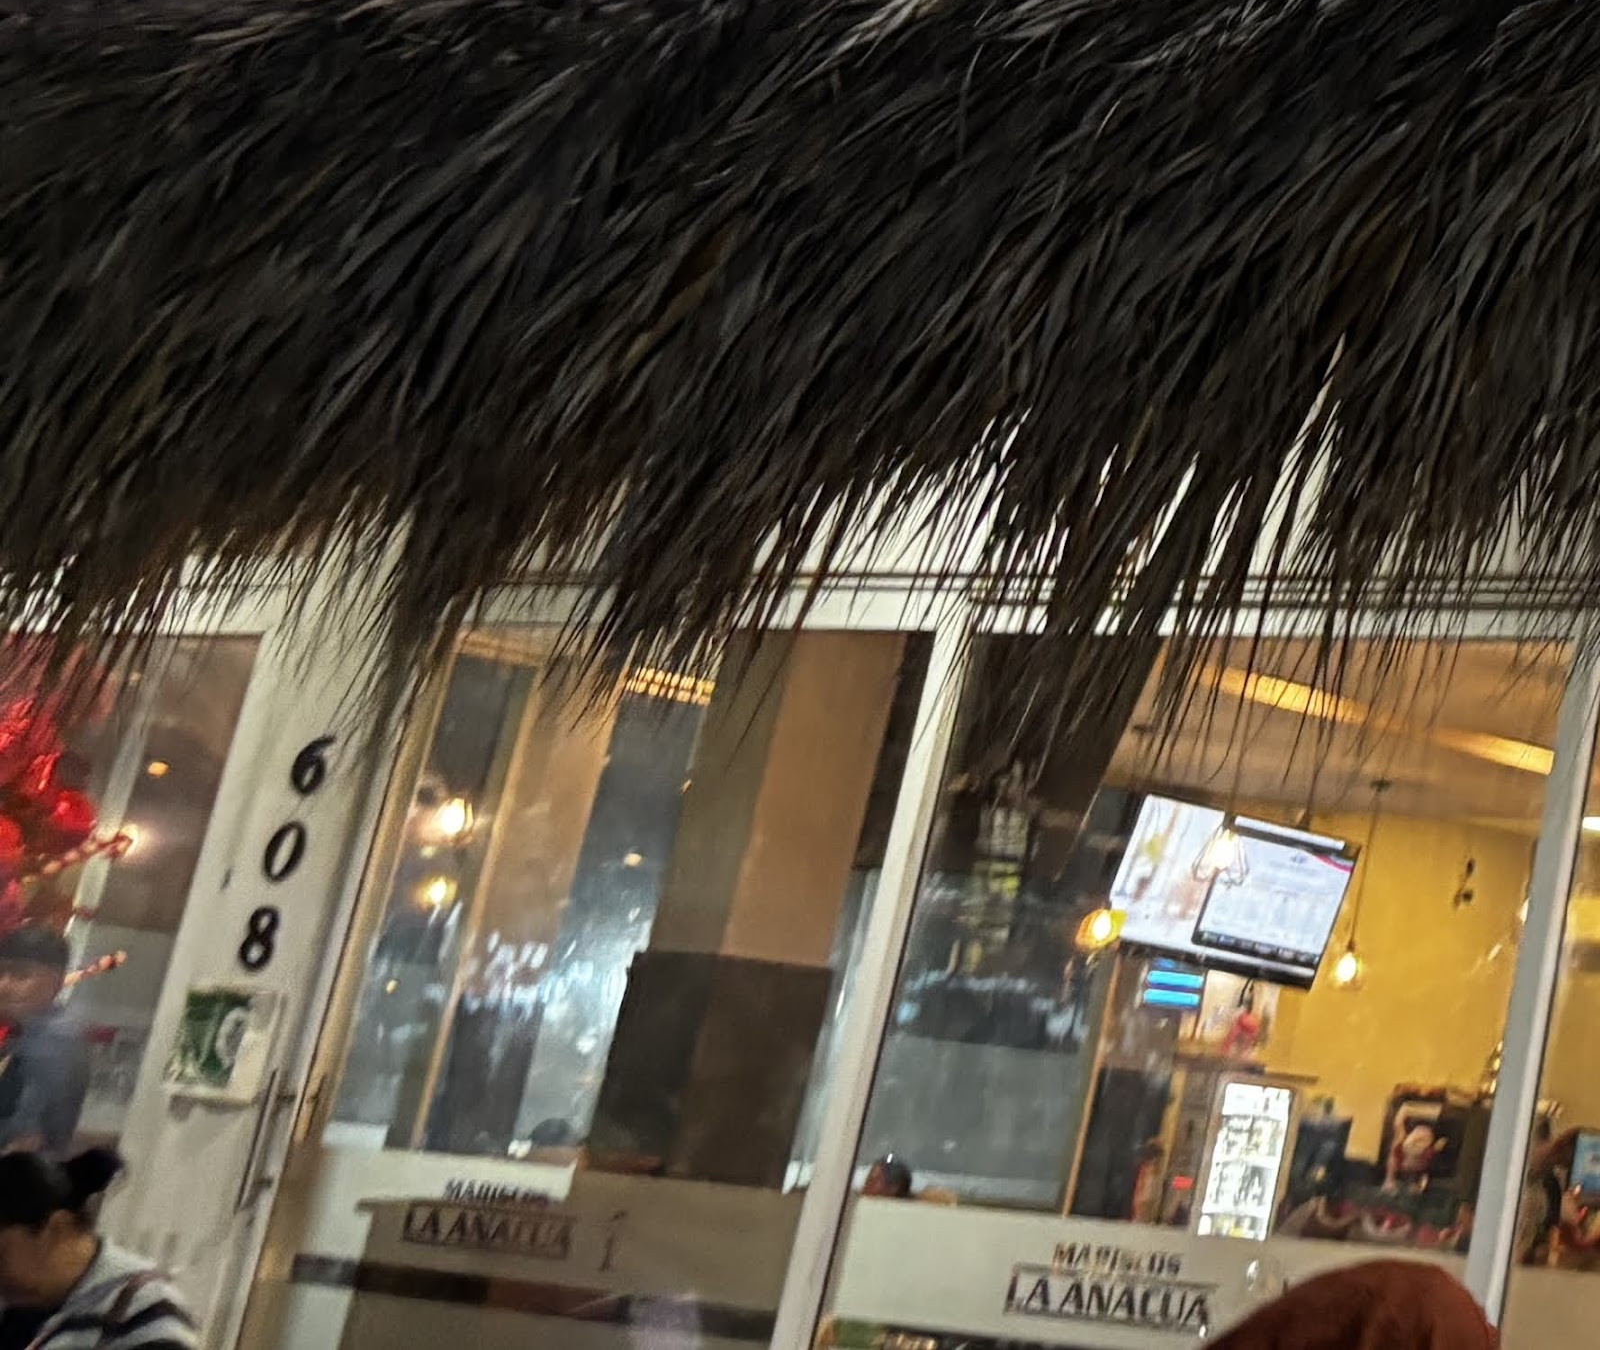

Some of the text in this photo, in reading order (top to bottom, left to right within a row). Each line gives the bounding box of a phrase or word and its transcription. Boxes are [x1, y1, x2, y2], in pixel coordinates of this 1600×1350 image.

[239, 733, 337, 973] 608
[443, 1176, 552, 1204] MARI
[1003, 1262, 1209, 1336] LA ANACUA
